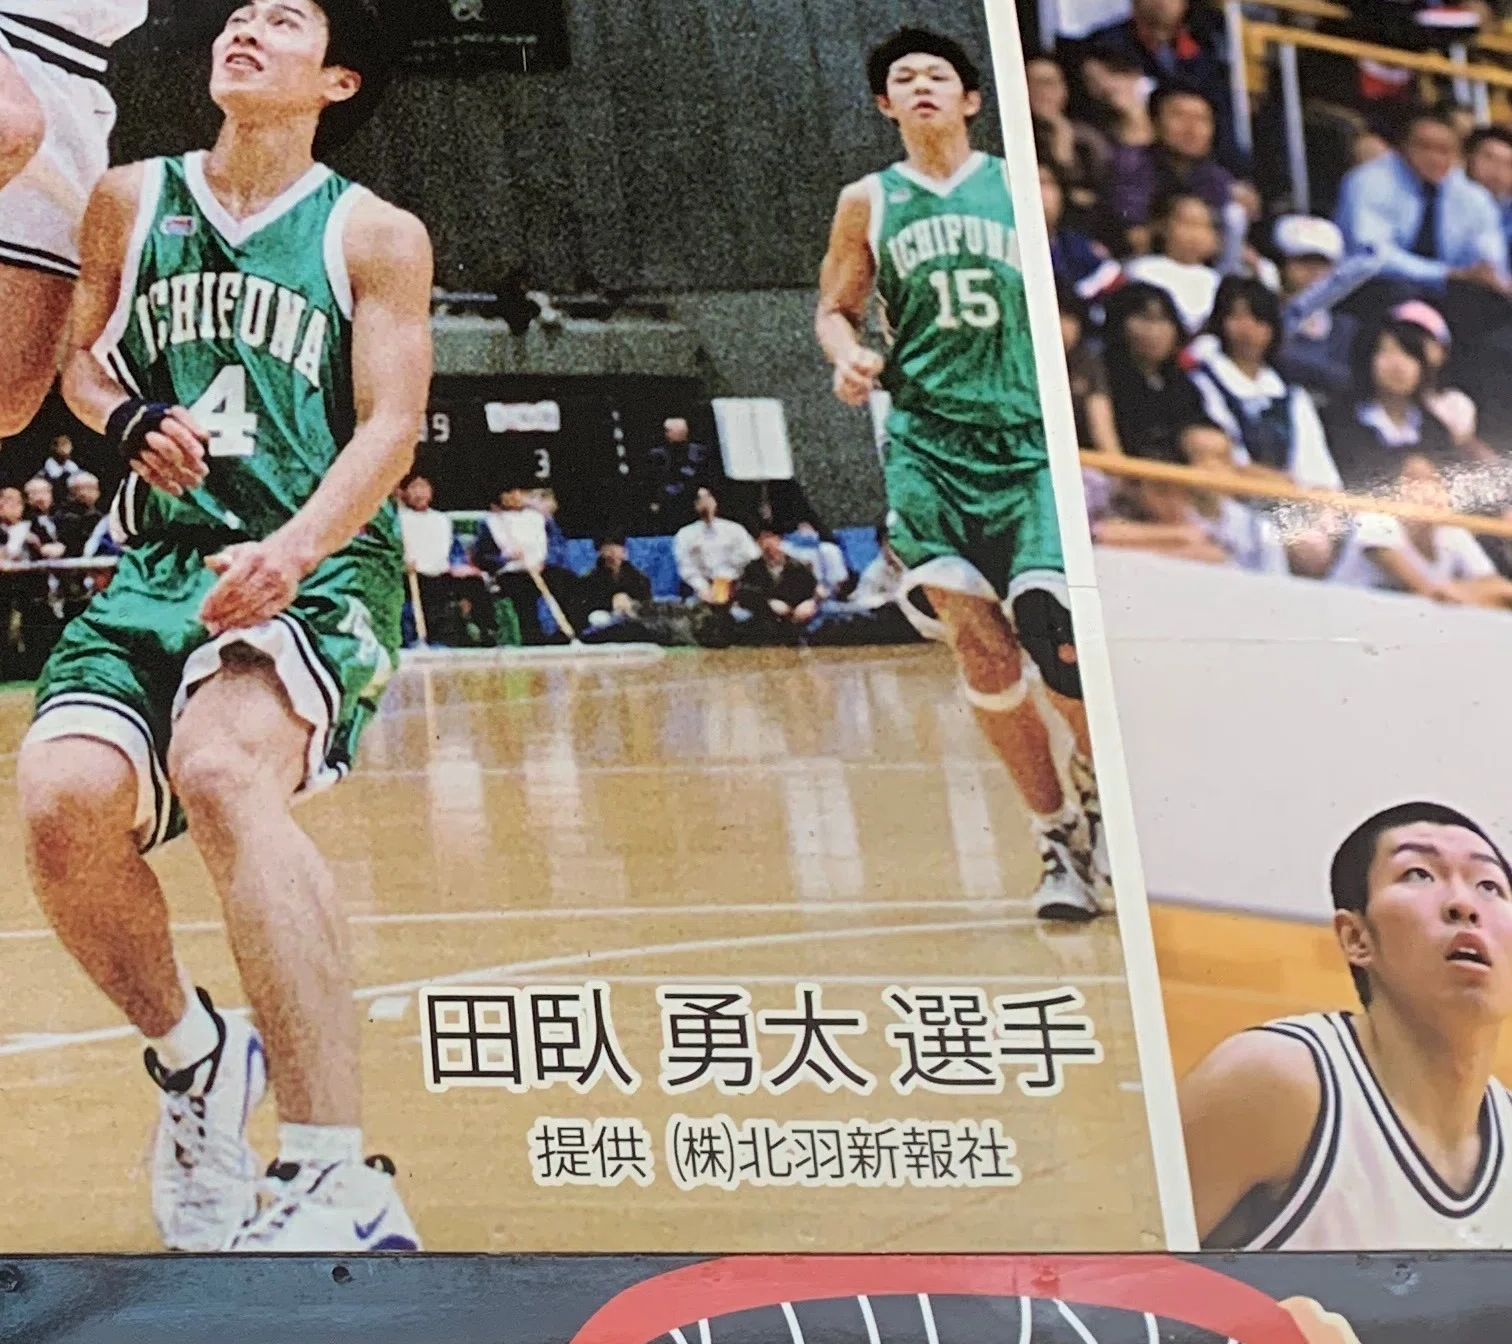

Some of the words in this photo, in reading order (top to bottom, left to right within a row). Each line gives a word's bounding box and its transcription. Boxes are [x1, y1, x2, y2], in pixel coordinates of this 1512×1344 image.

[929, 268, 1000, 328] 15
[190, 364, 258, 457] 4
[428, 990, 631, 1084] 田臥
[665, 991, 866, 1086] 勇太
[892, 994, 1094, 1087] 選手
[536, 1126, 645, 1177] 提供
